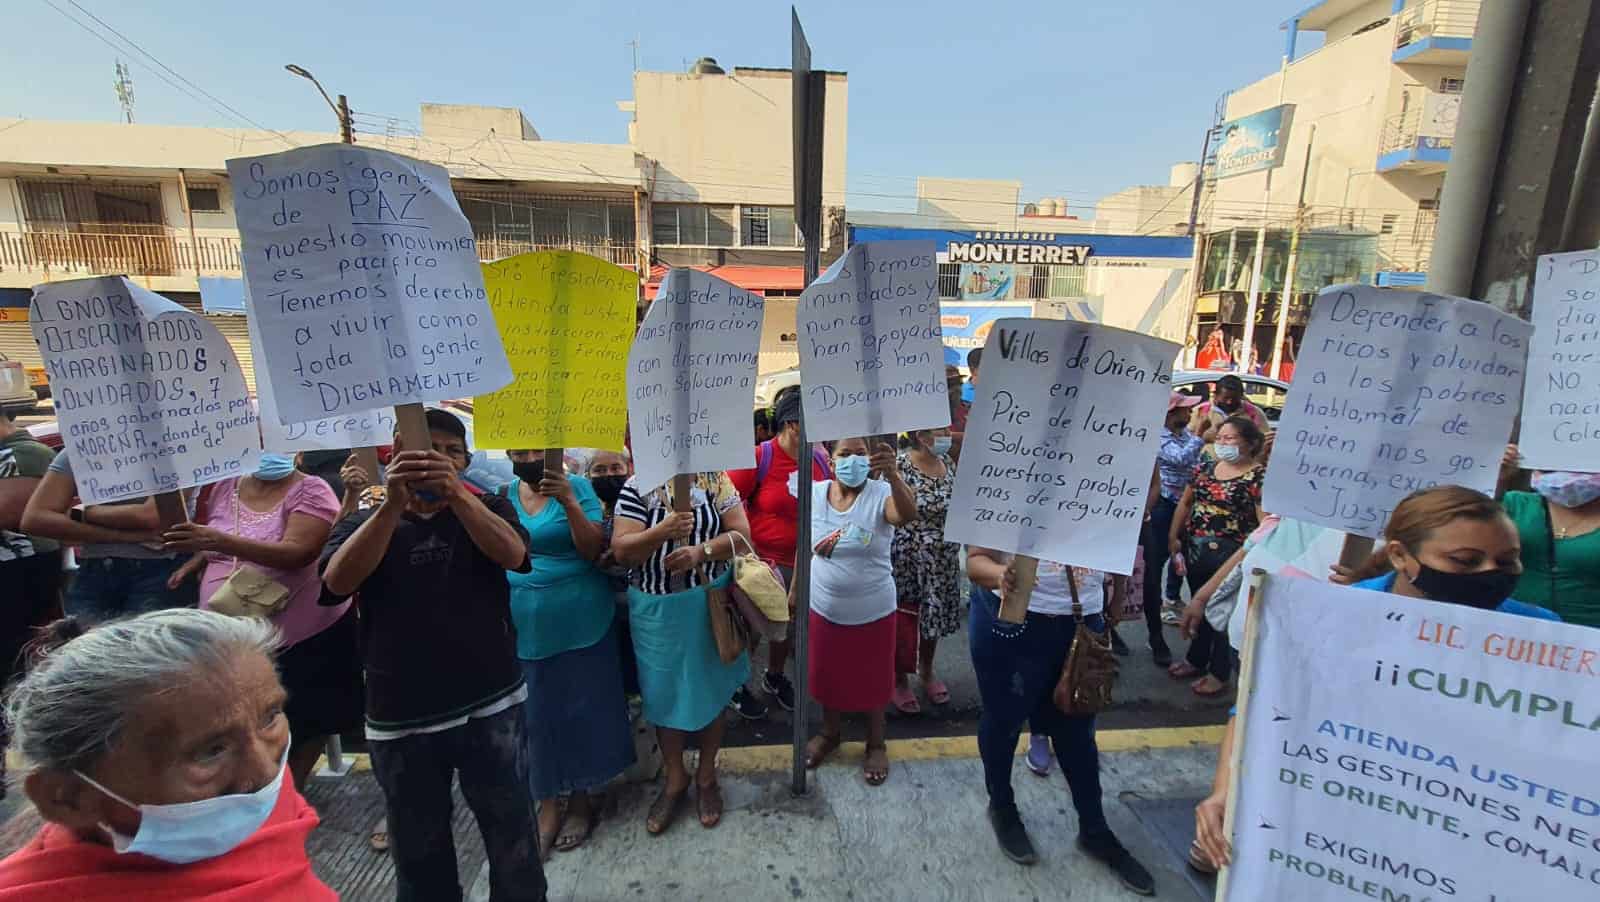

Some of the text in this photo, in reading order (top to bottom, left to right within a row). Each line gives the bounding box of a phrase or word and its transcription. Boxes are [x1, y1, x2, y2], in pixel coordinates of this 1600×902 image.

[243, 162, 340, 200] Somos
[272, 200, 301, 226] de
[264, 224, 367, 262] nuestro
[950, 242, 1091, 265] MONTERREY
[273, 269, 304, 283] es
[863, 250, 931, 273] hemos
[268, 273, 485, 314] Tenemos derecho
[665, 281, 720, 317] puede
[295, 312, 478, 346] a vivir como
[806, 314, 871, 335] nunca
[1331, 291, 1449, 334] Defender
[1460, 322, 1478, 336] a
[1492, 319, 1521, 348] los
[49, 348, 208, 380] MARGINADOS
[293, 344, 353, 378] toda
[422, 333, 480, 366] gente
[810, 338, 850, 359] han
[1000, 328, 1049, 364] Villas
[1065, 335, 1089, 370] de
[1322, 336, 1391, 360] ricos
[638, 358, 661, 374] con
[856, 357, 884, 373] nos
[209, 377, 221, 400] 7
[739, 376, 749, 388] a
[1050, 383, 1078, 399] en
[1312, 366, 1506, 410] a los pobres
[1549, 371, 1580, 392] NO
[117, 400, 222, 432] gobernados
[688, 400, 709, 425] de
[992, 390, 1149, 442] Pie de lucha
[1442, 413, 1470, 435] de
[661, 427, 720, 458] Oriente
[1296, 425, 1355, 456] quien
[1378, 443, 1428, 465] nos
[1097, 453, 1114, 466] a
[152, 467, 179, 485] los
[980, 461, 1140, 498] nuestros proble
[976, 486, 1139, 521] mas de regulari
[1282, 740, 1329, 765] LAS
[1337, 755, 1521, 823] GESTIONES
[1316, 719, 1600, 817] ATIENDA USTED
[1279, 768, 1315, 790] DE
[1322, 780, 1470, 840] ORIENTE,
[1304, 831, 1457, 895] EXIGIMOS
